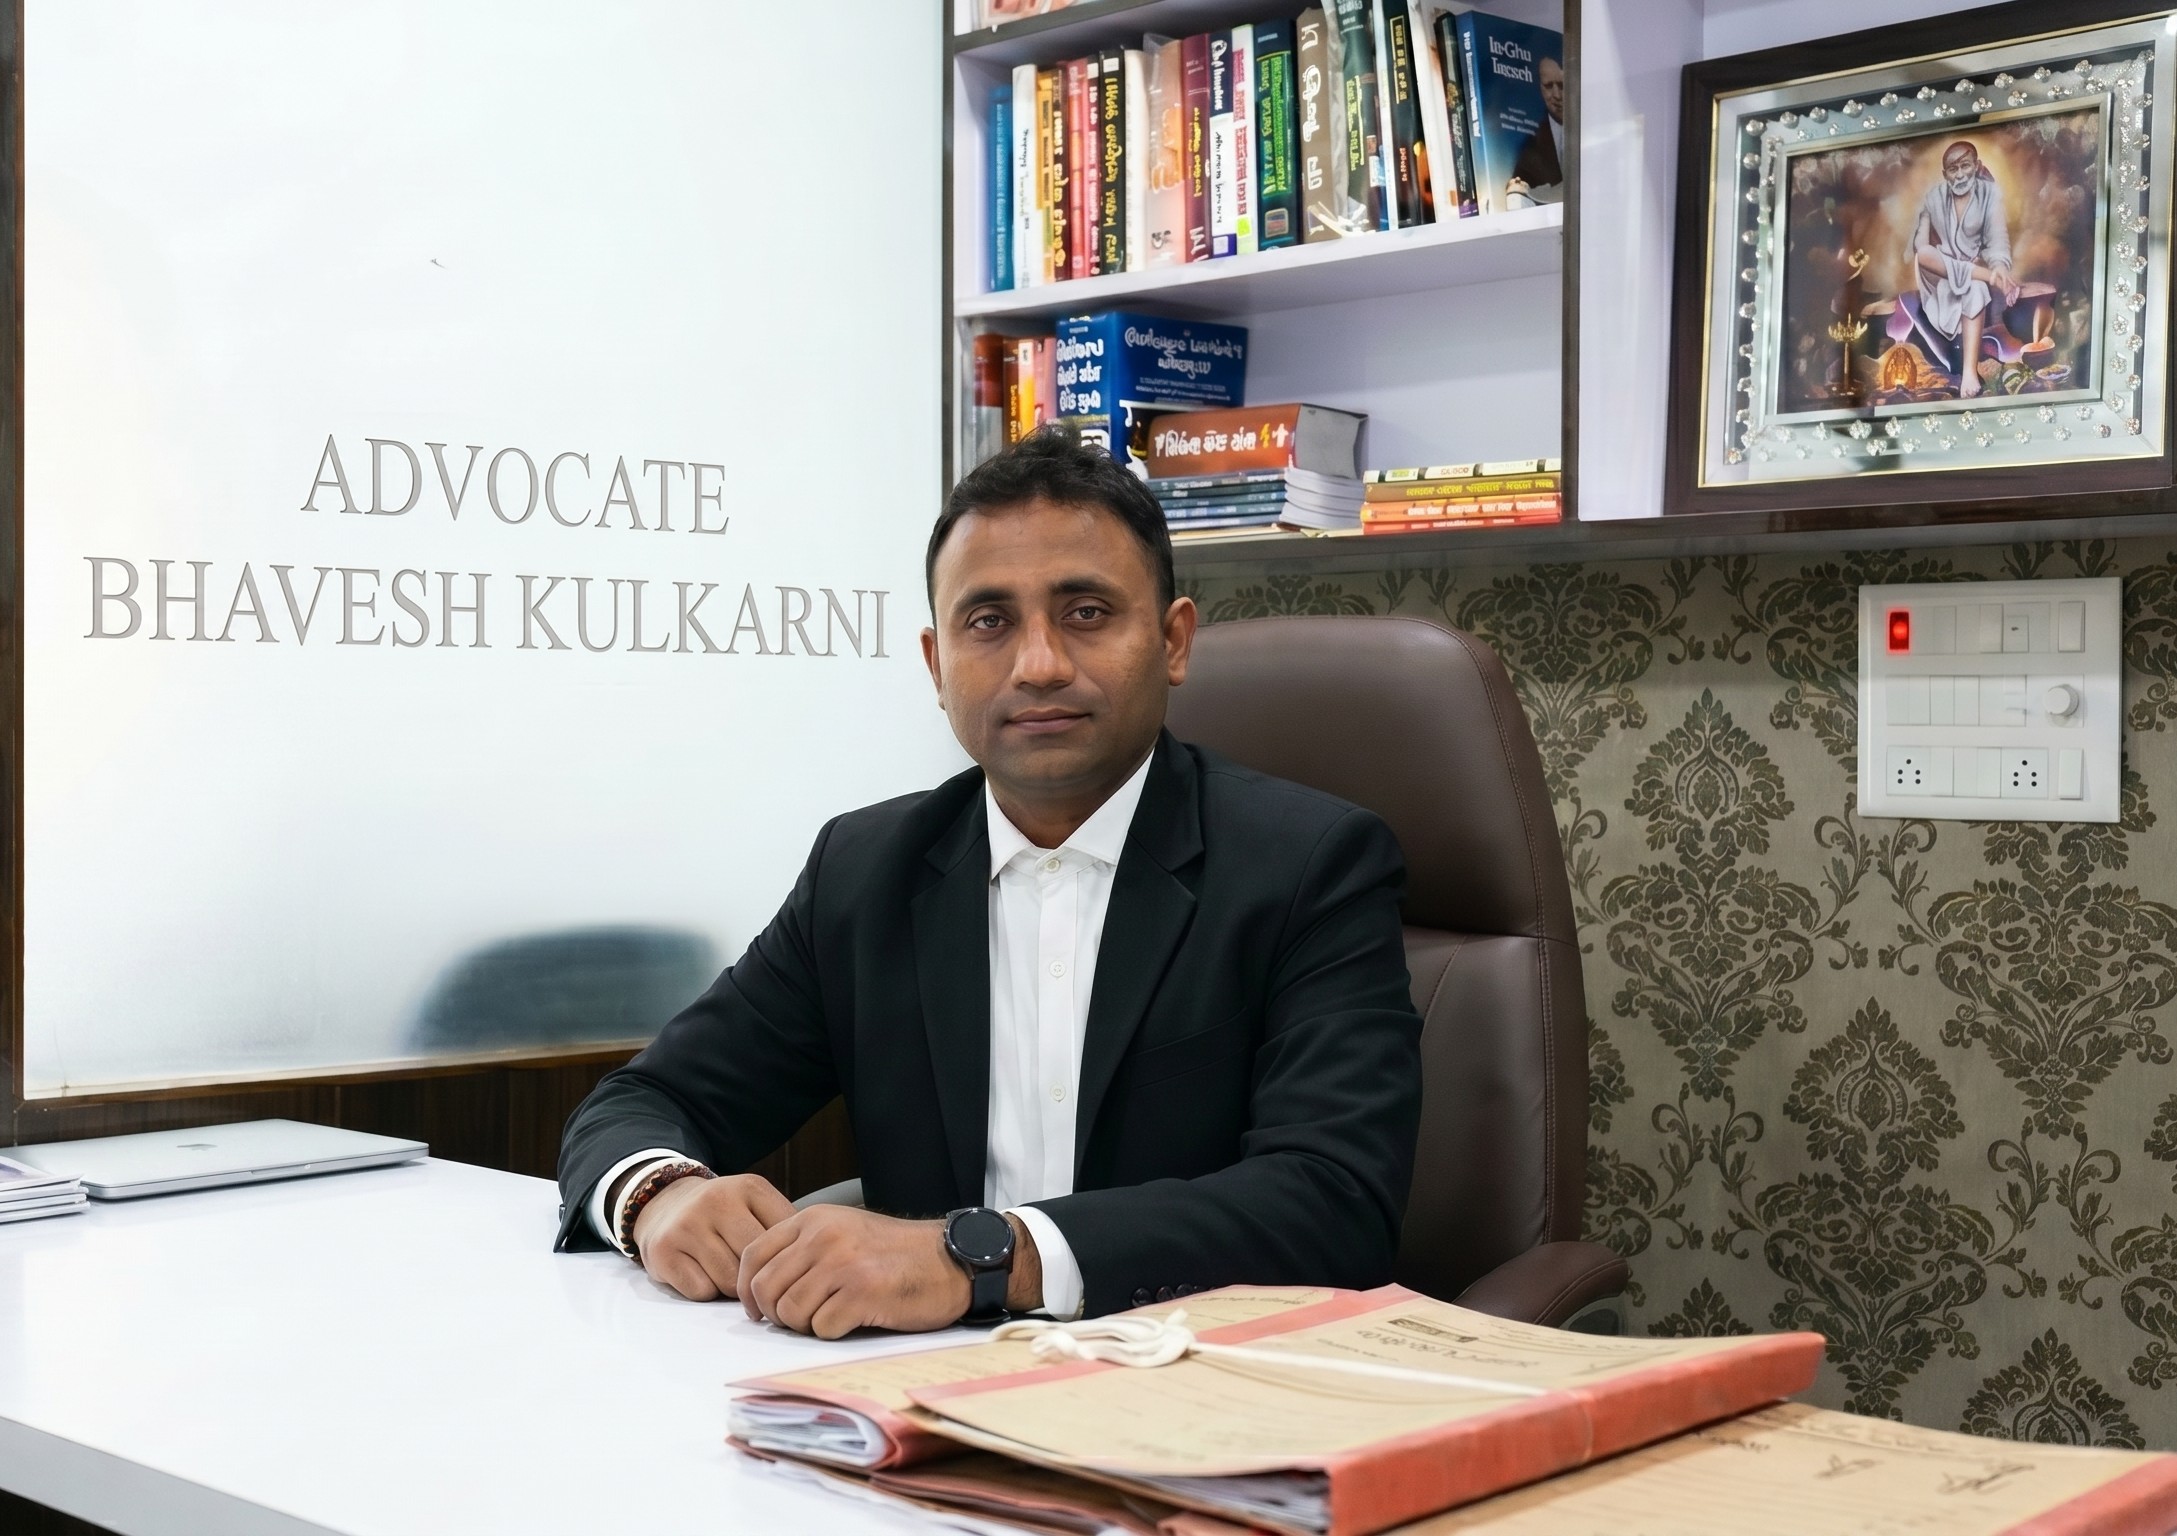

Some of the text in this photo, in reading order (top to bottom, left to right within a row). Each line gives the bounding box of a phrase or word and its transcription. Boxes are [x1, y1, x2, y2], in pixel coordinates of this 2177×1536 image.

[300, 434, 730, 535] ADVOCATE
[83, 557, 891, 658] BHAVESH KULKARNI
